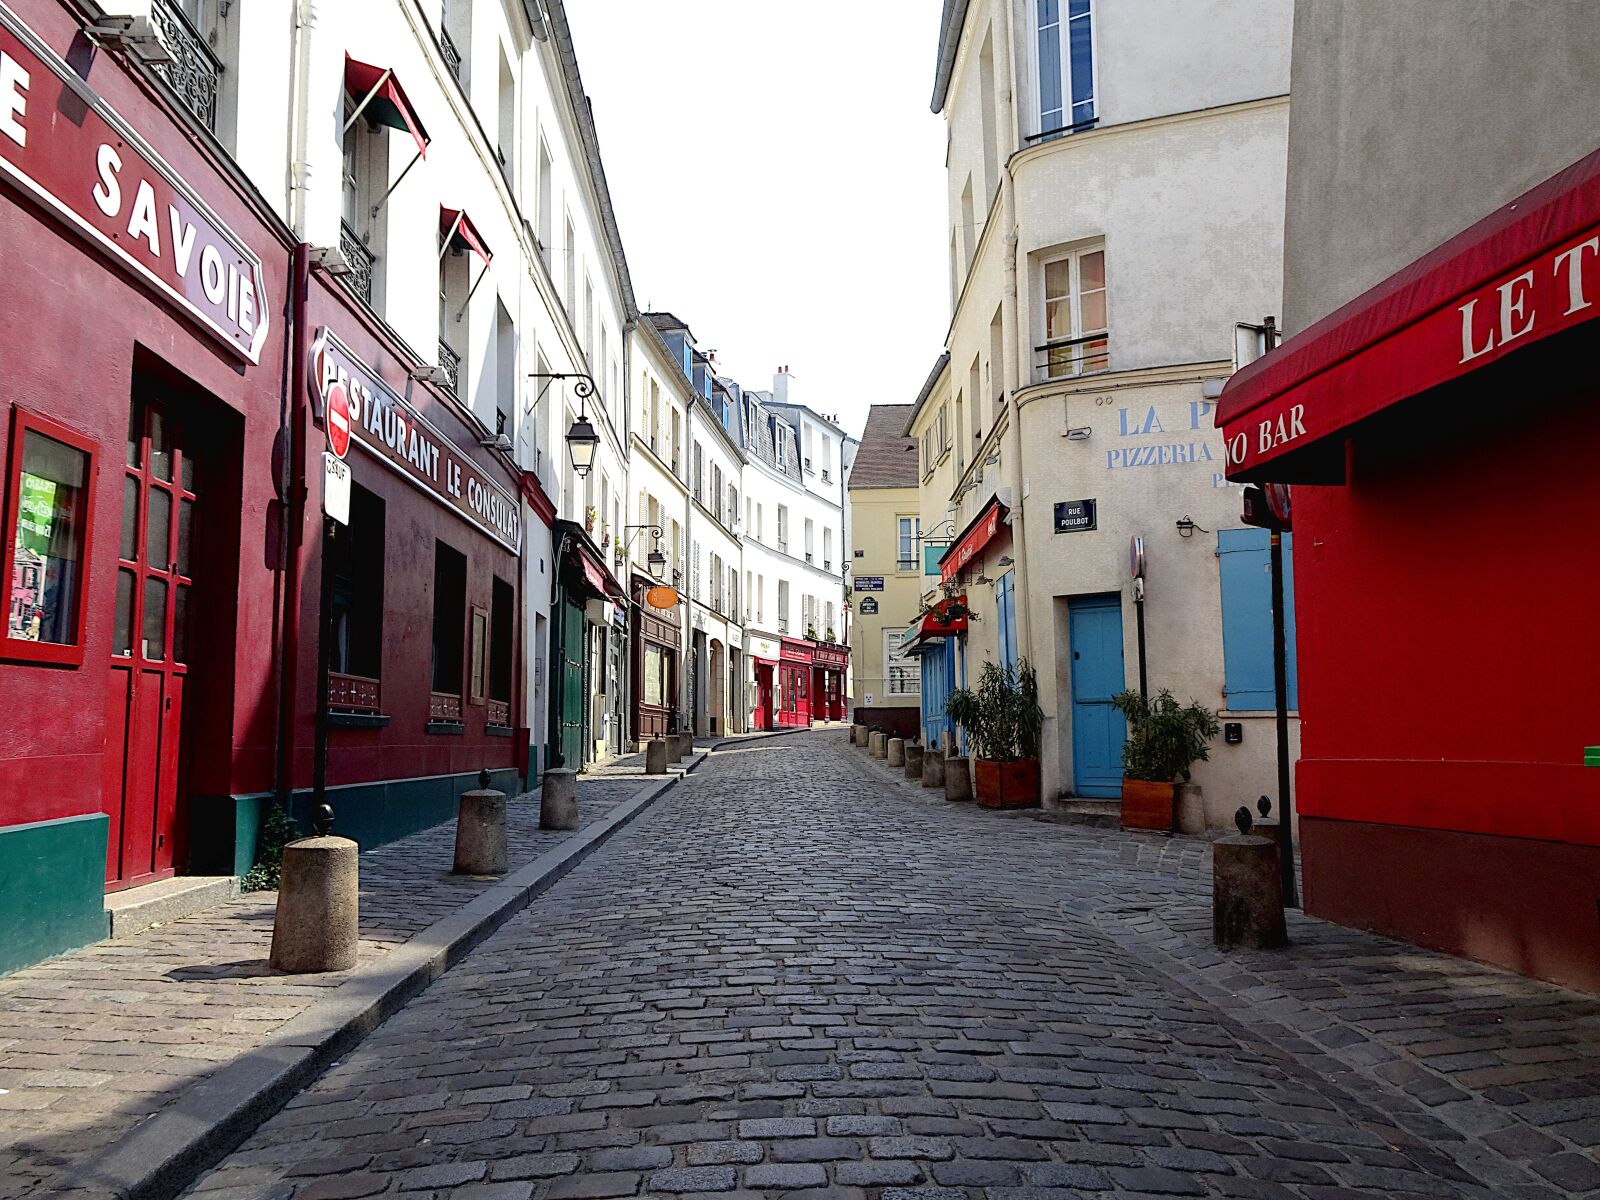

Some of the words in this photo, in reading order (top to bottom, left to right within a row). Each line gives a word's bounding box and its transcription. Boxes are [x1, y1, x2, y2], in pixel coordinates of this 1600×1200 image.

[93, 143, 254, 336] SAVOIE
[1459, 270, 1536, 364] LE
[1118, 404, 1165, 437] LA
[1258, 403, 1307, 454] BAR
[1106, 441, 1213, 470] PIZZERIA
[447, 458, 461, 499] LE
[467, 477, 517, 542] CONSULAT
[1068, 507, 1081, 516] RUE
[1061, 516, 1089, 527] POULBOT
